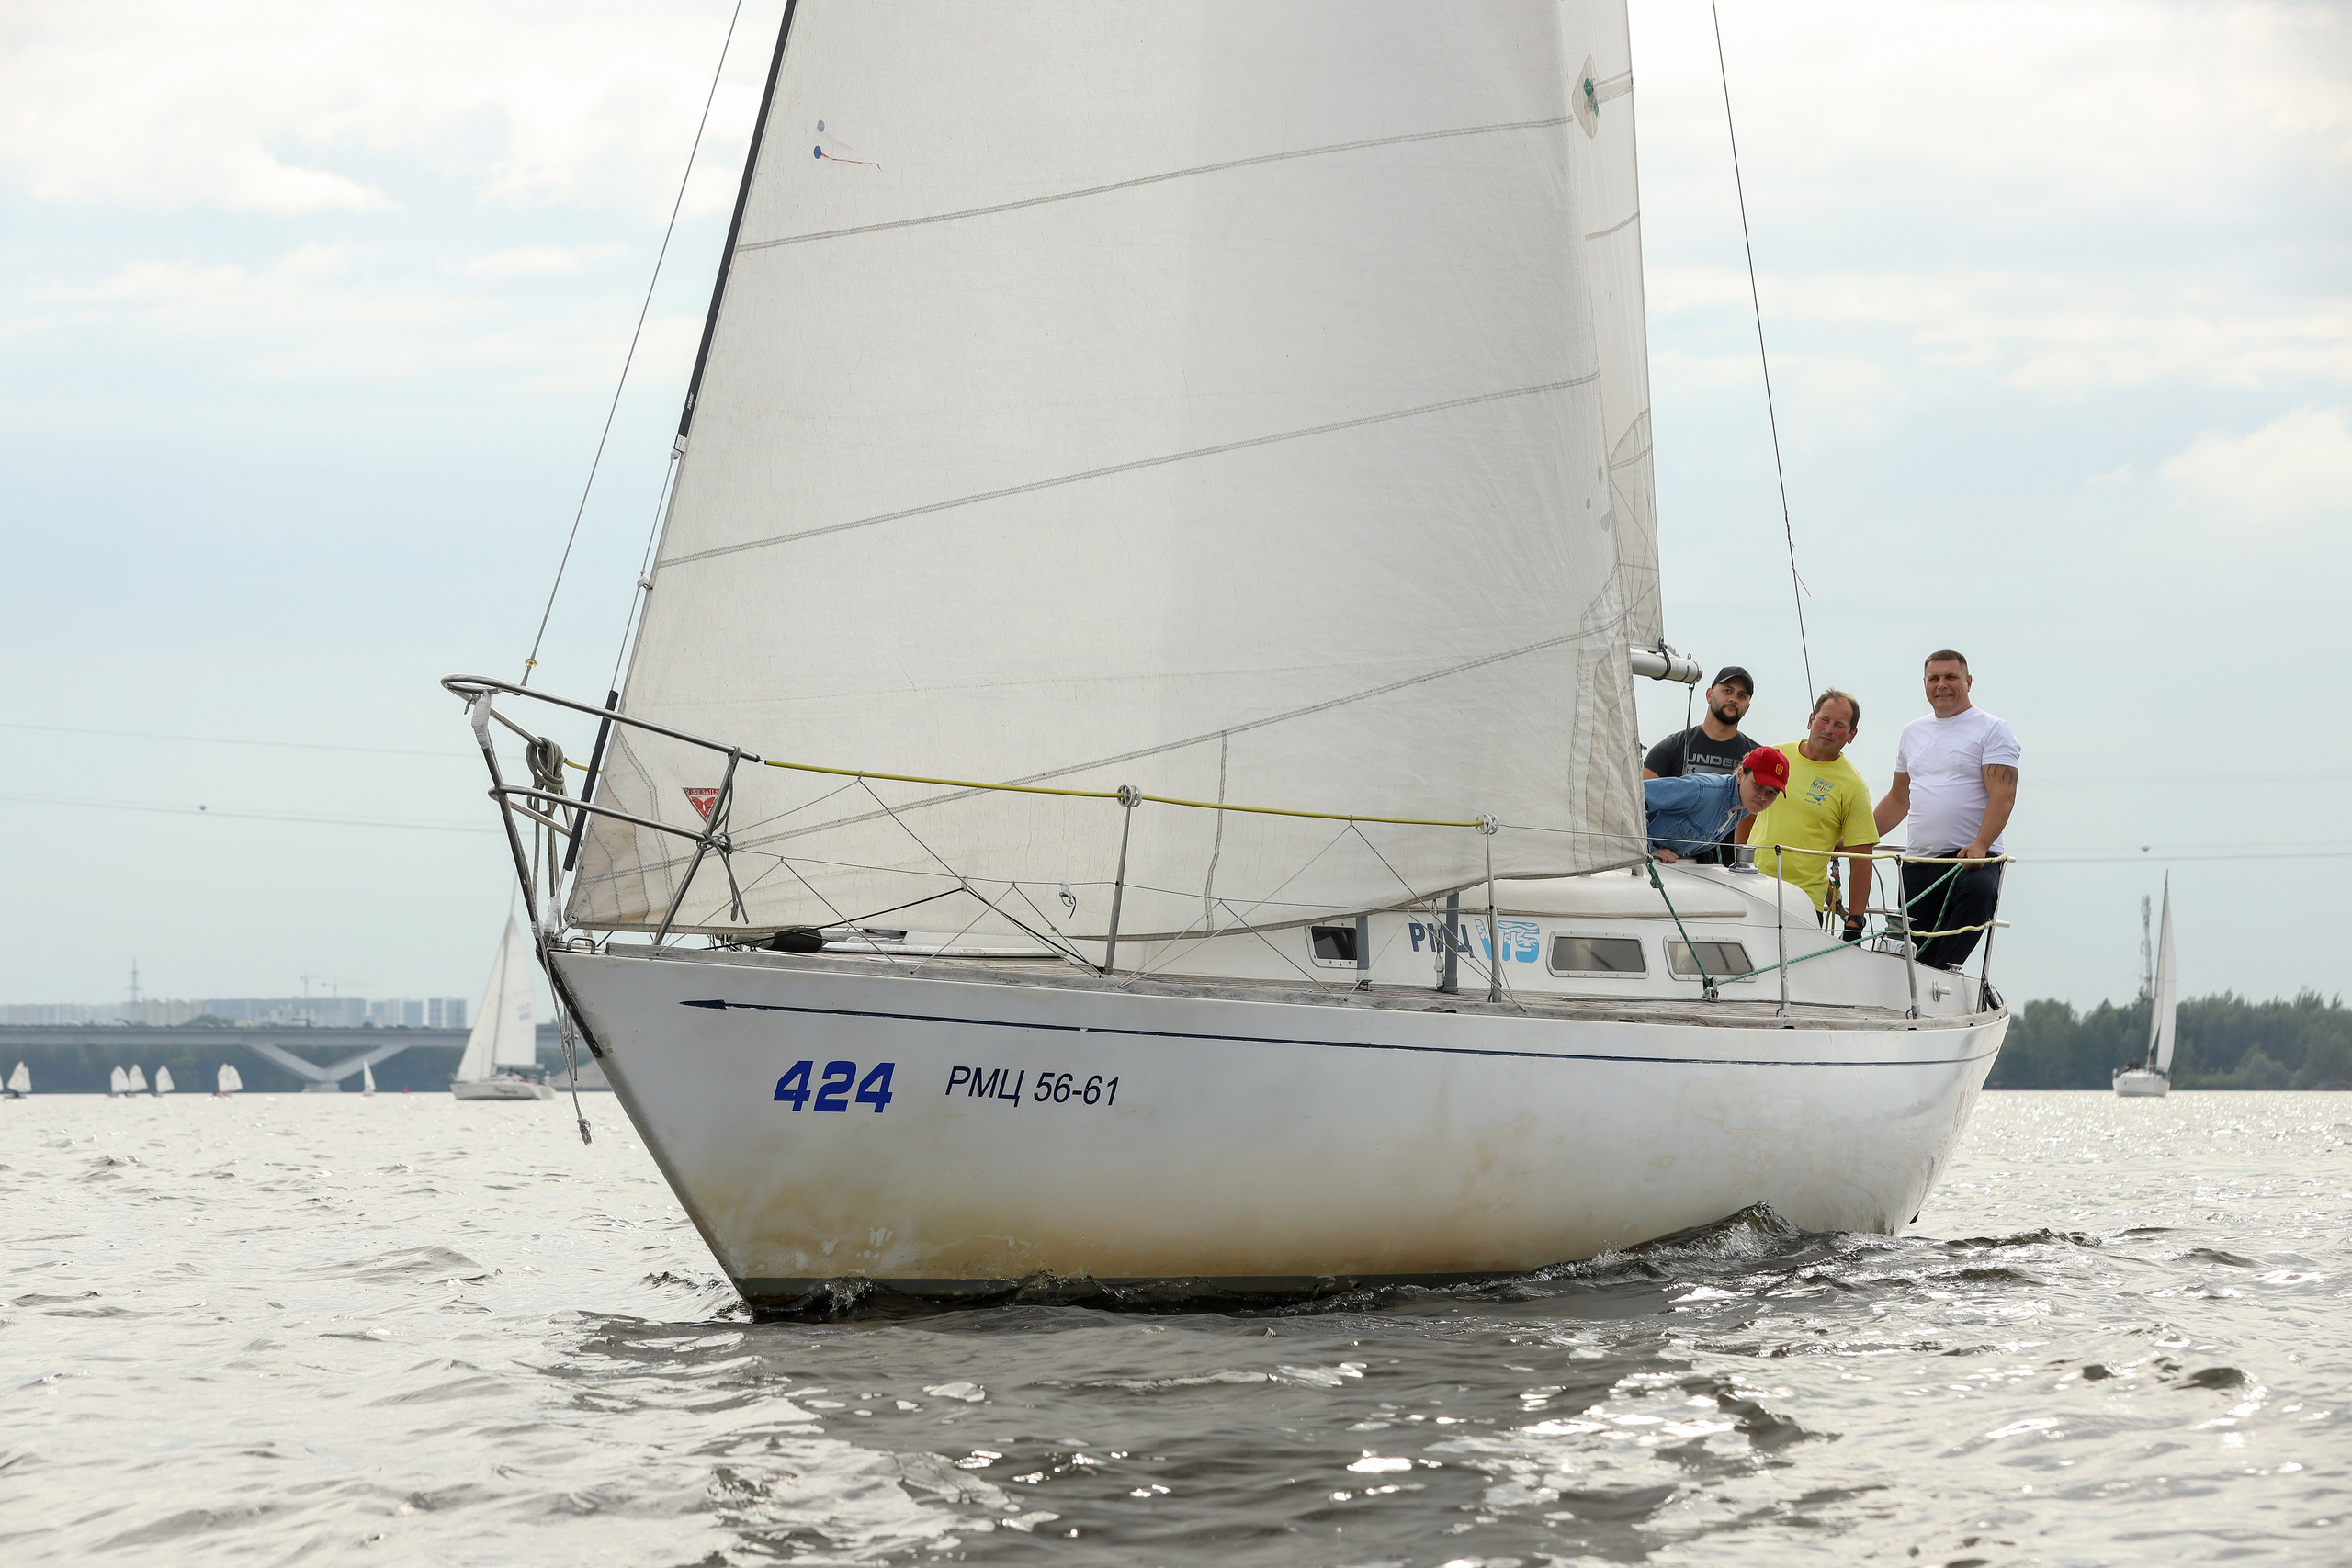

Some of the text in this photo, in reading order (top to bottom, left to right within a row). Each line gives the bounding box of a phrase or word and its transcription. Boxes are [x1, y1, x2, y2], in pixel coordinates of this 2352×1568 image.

[773, 1060, 896, 1113] 424
[945, 1066, 1120, 1107] РМЦ 56-61
